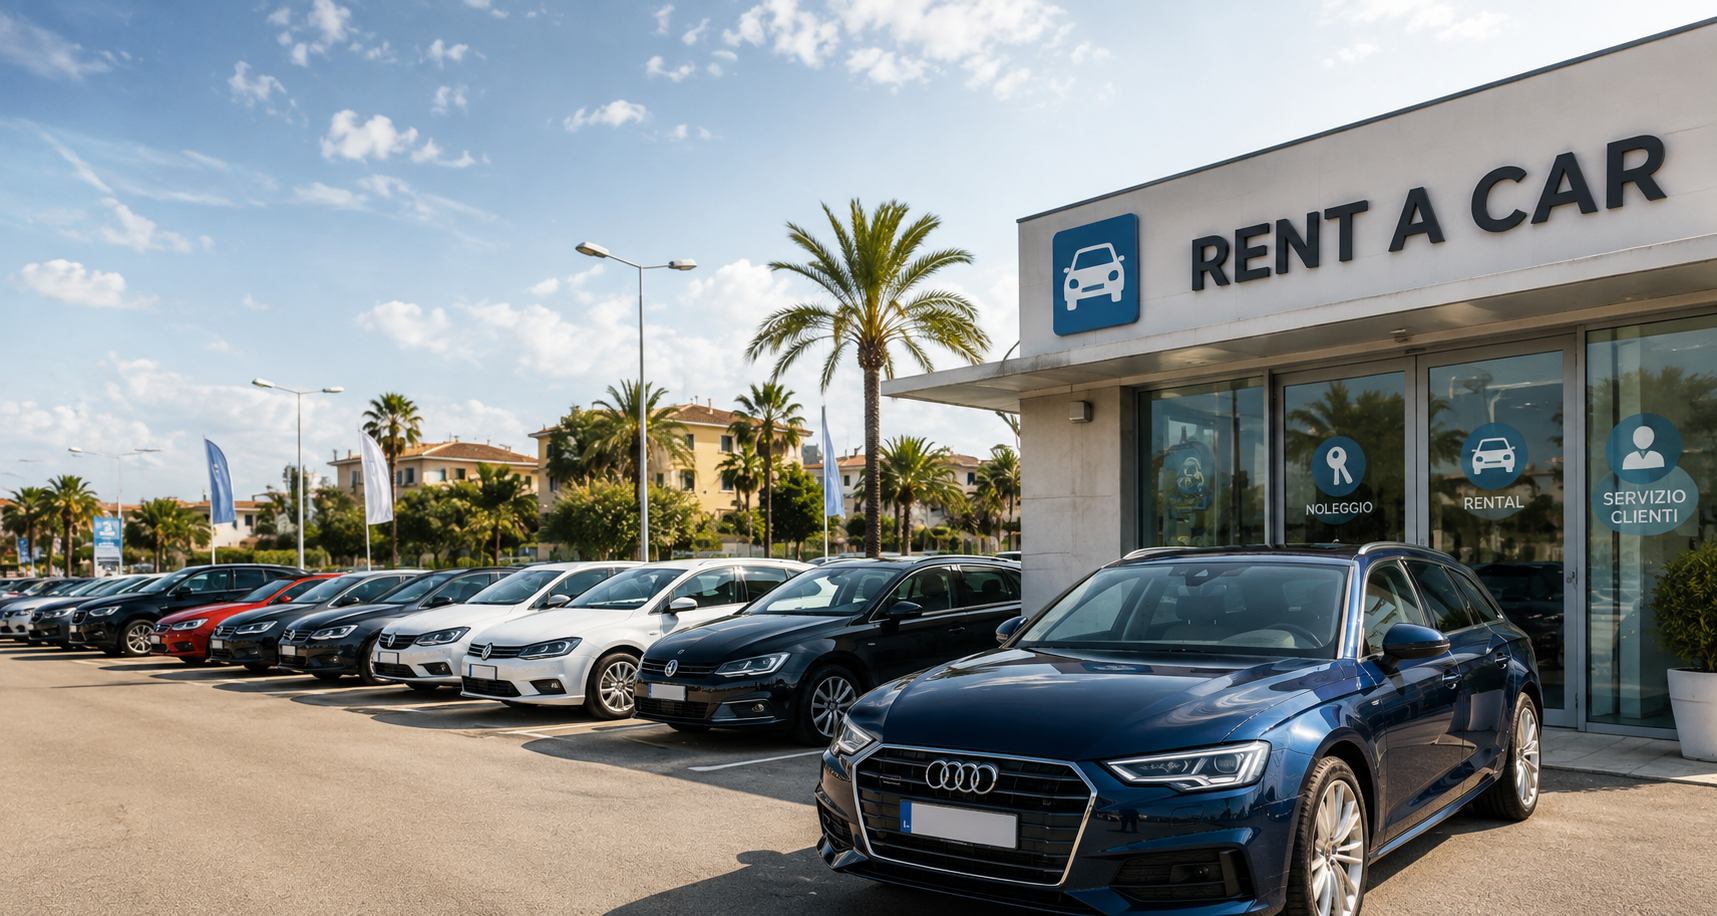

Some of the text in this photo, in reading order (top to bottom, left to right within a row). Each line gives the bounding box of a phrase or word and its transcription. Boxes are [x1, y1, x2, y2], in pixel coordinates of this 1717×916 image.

[1191, 134, 1667, 291] RENT A CAR
[1464, 495, 1525, 510] RENTAL
[1603, 489, 1686, 506] SERVIZIO
[1305, 501, 1373, 516] NOLEGGIO
[1610, 508, 1678, 524] CLIENTI
